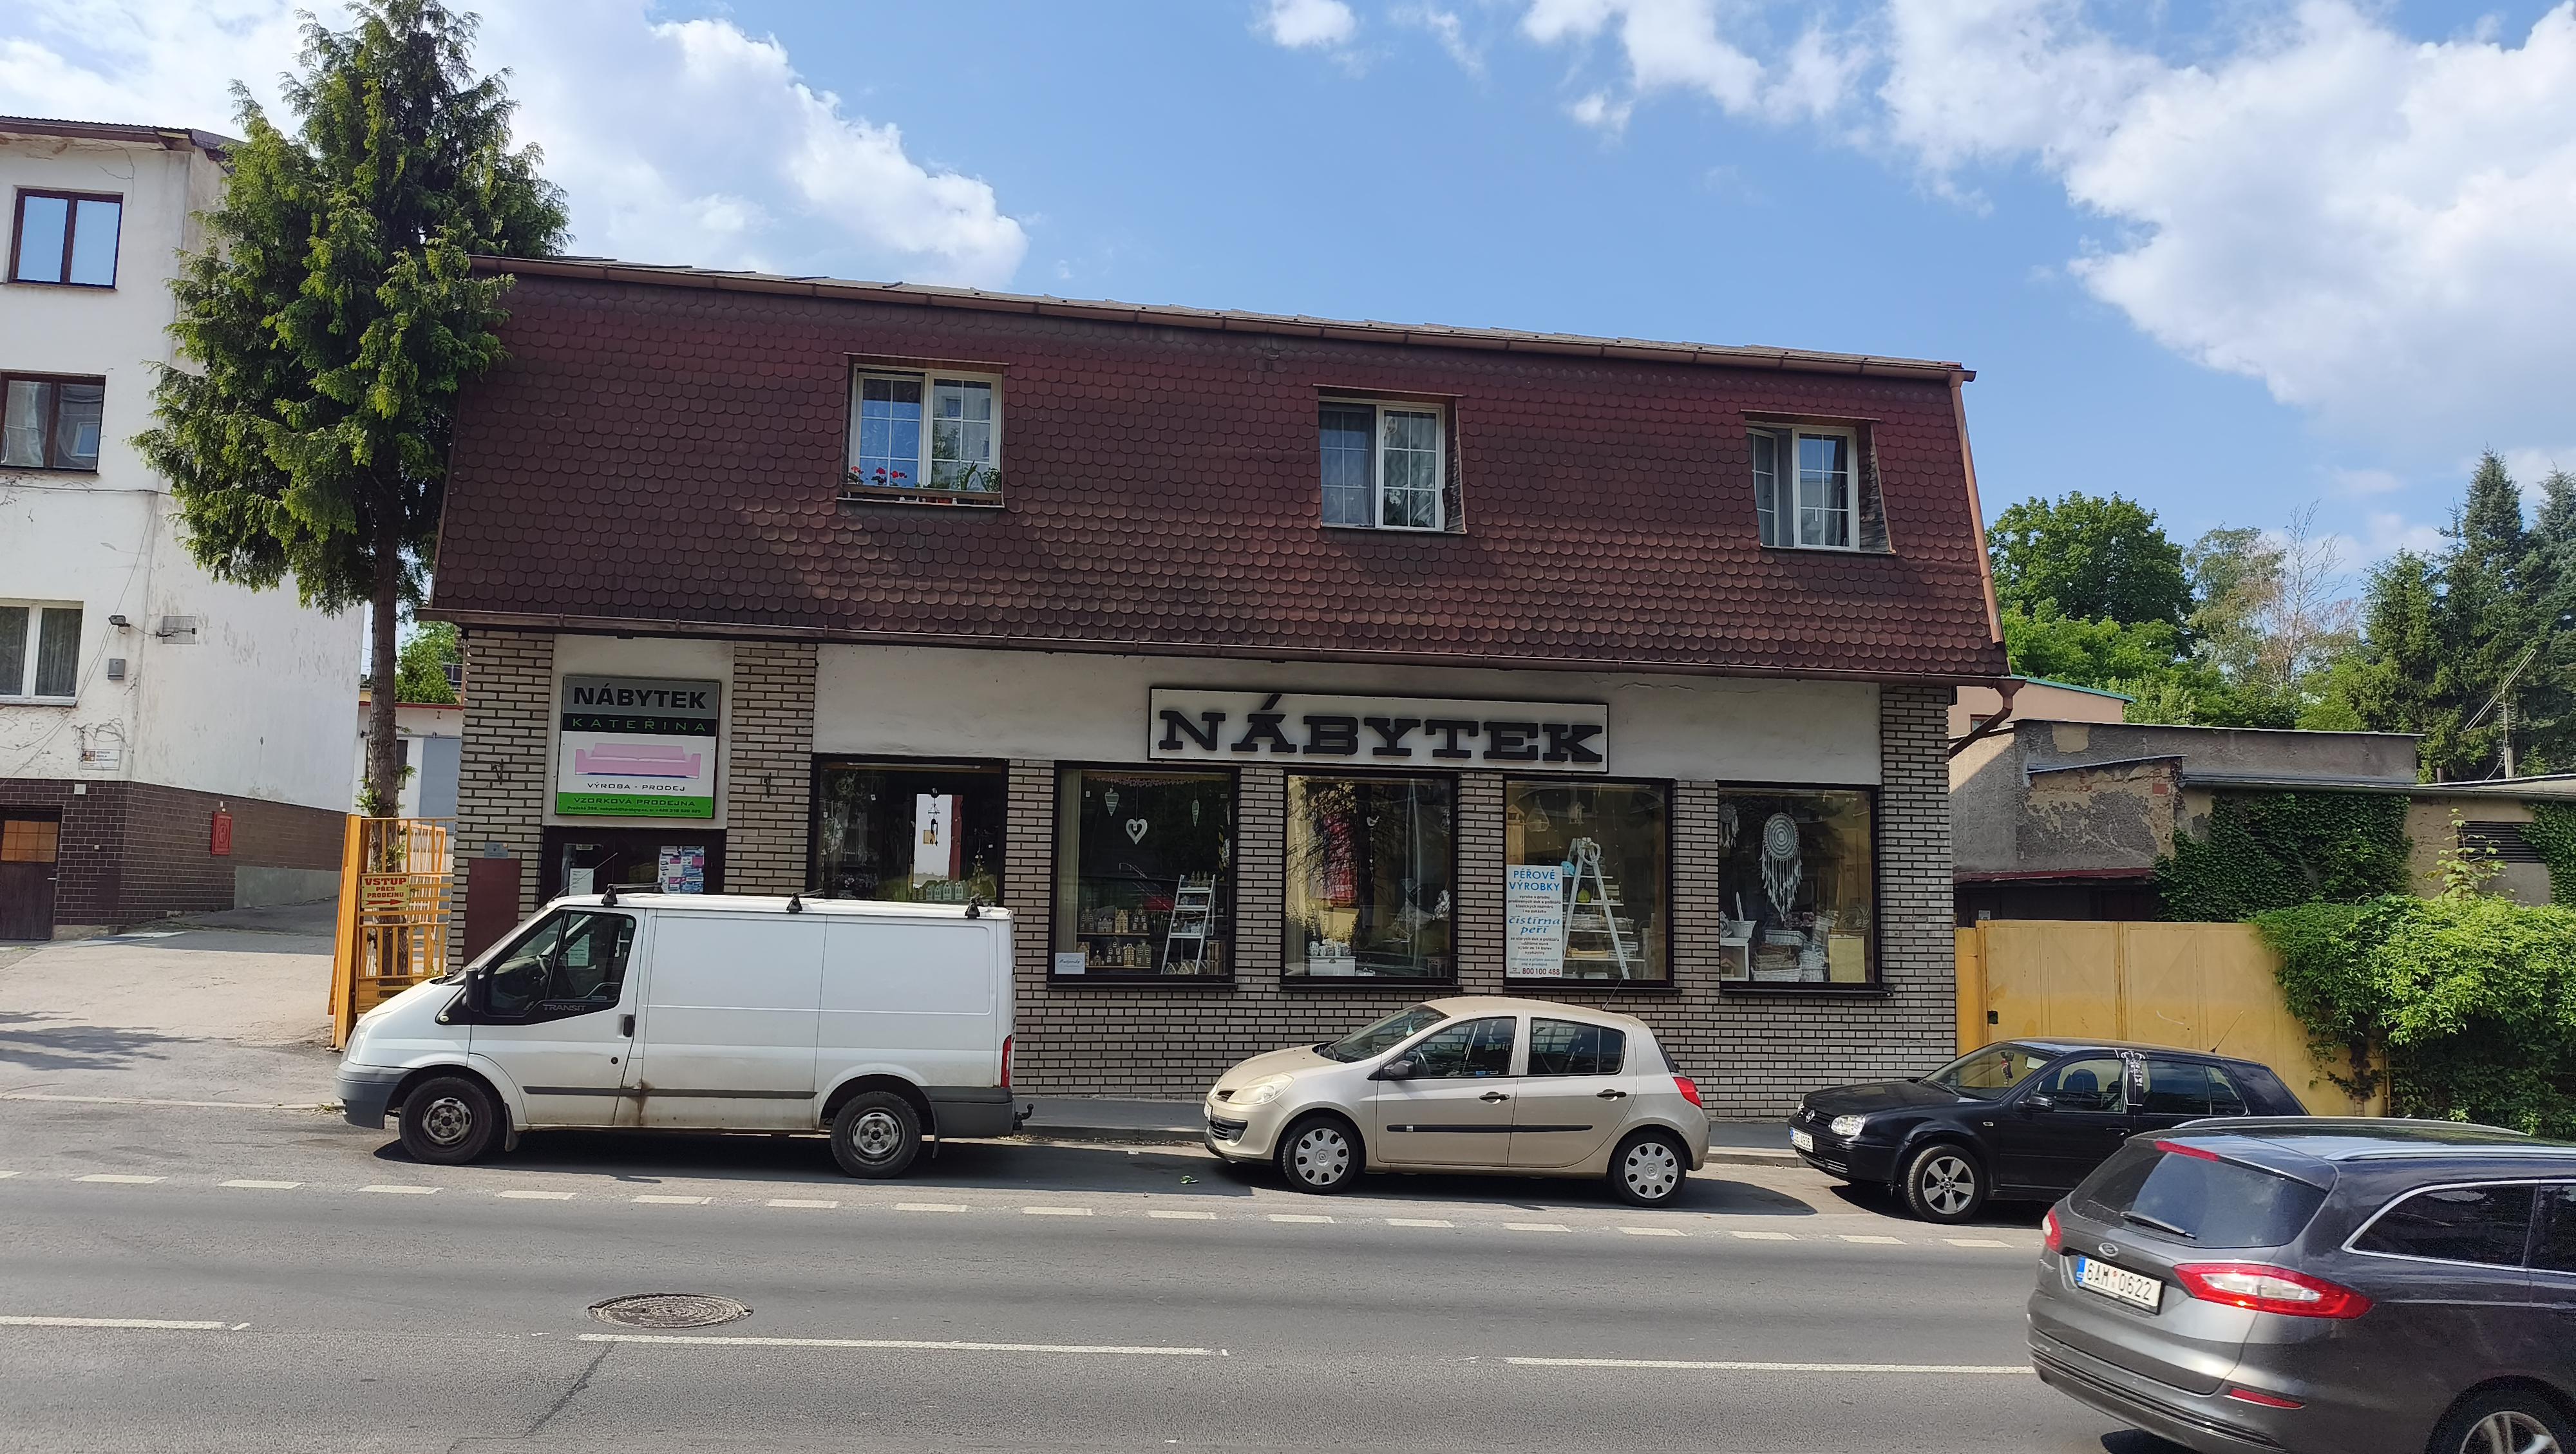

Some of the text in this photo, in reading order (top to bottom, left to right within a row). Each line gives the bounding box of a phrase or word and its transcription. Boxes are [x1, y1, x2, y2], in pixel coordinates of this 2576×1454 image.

[573, 683, 706, 710] NÁBYTEK
[573, 718, 706, 732] KATEŘINA
[1158, 694, 1603, 763] NÁBYTEK
[1513, 868, 1555, 880] PÉŘOVÉ
[365, 877, 406, 885] VSTUP
[1508, 880, 1560, 891] VÝROBKY
[1508, 915, 1560, 925] čistírna
[1520, 925, 1549, 936] peří
[2118, 1273, 2152, 1301] 0622
